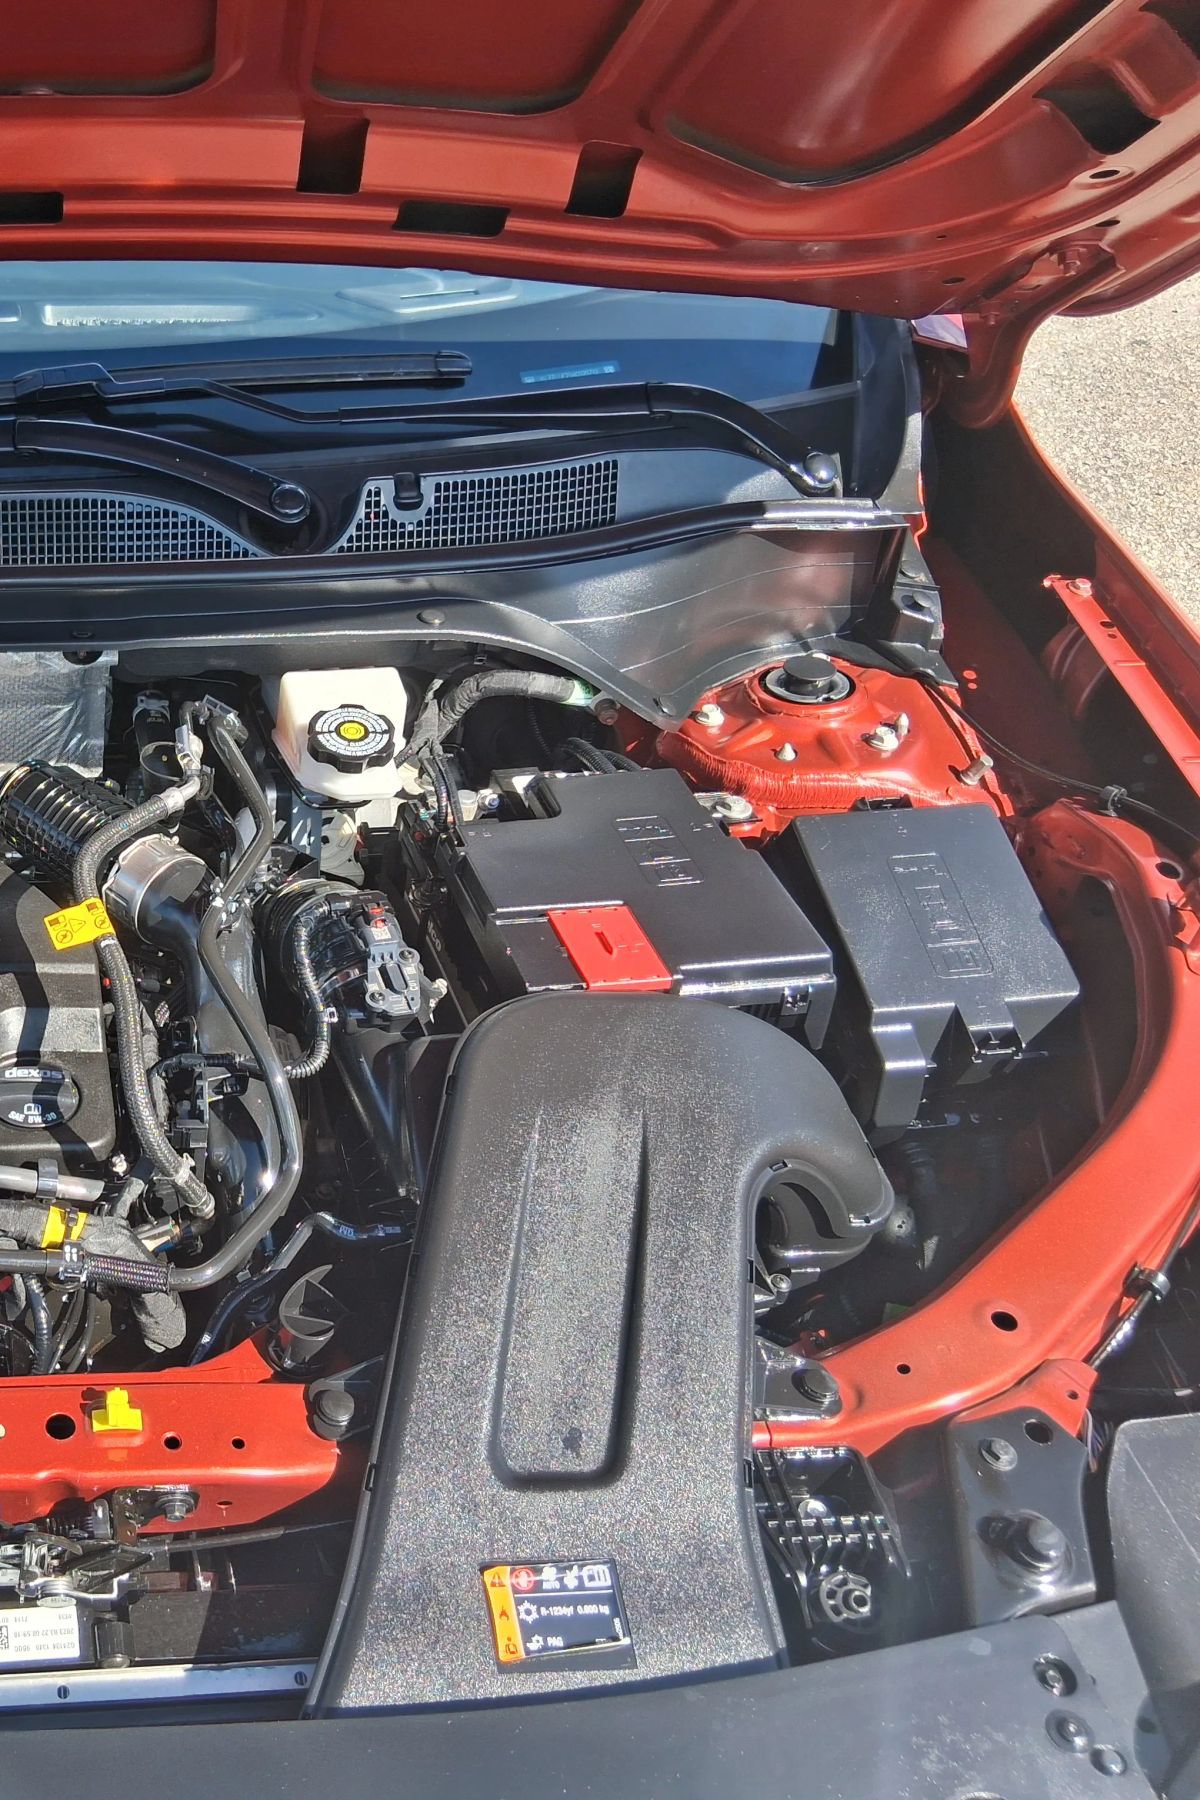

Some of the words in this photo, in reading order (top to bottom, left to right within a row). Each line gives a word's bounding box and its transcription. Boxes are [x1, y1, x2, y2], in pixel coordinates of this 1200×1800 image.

[4, 1067, 63, 1078] dexos
[8, 1111, 25, 1123] SAE
[547, 1636, 563, 1647] PAG
